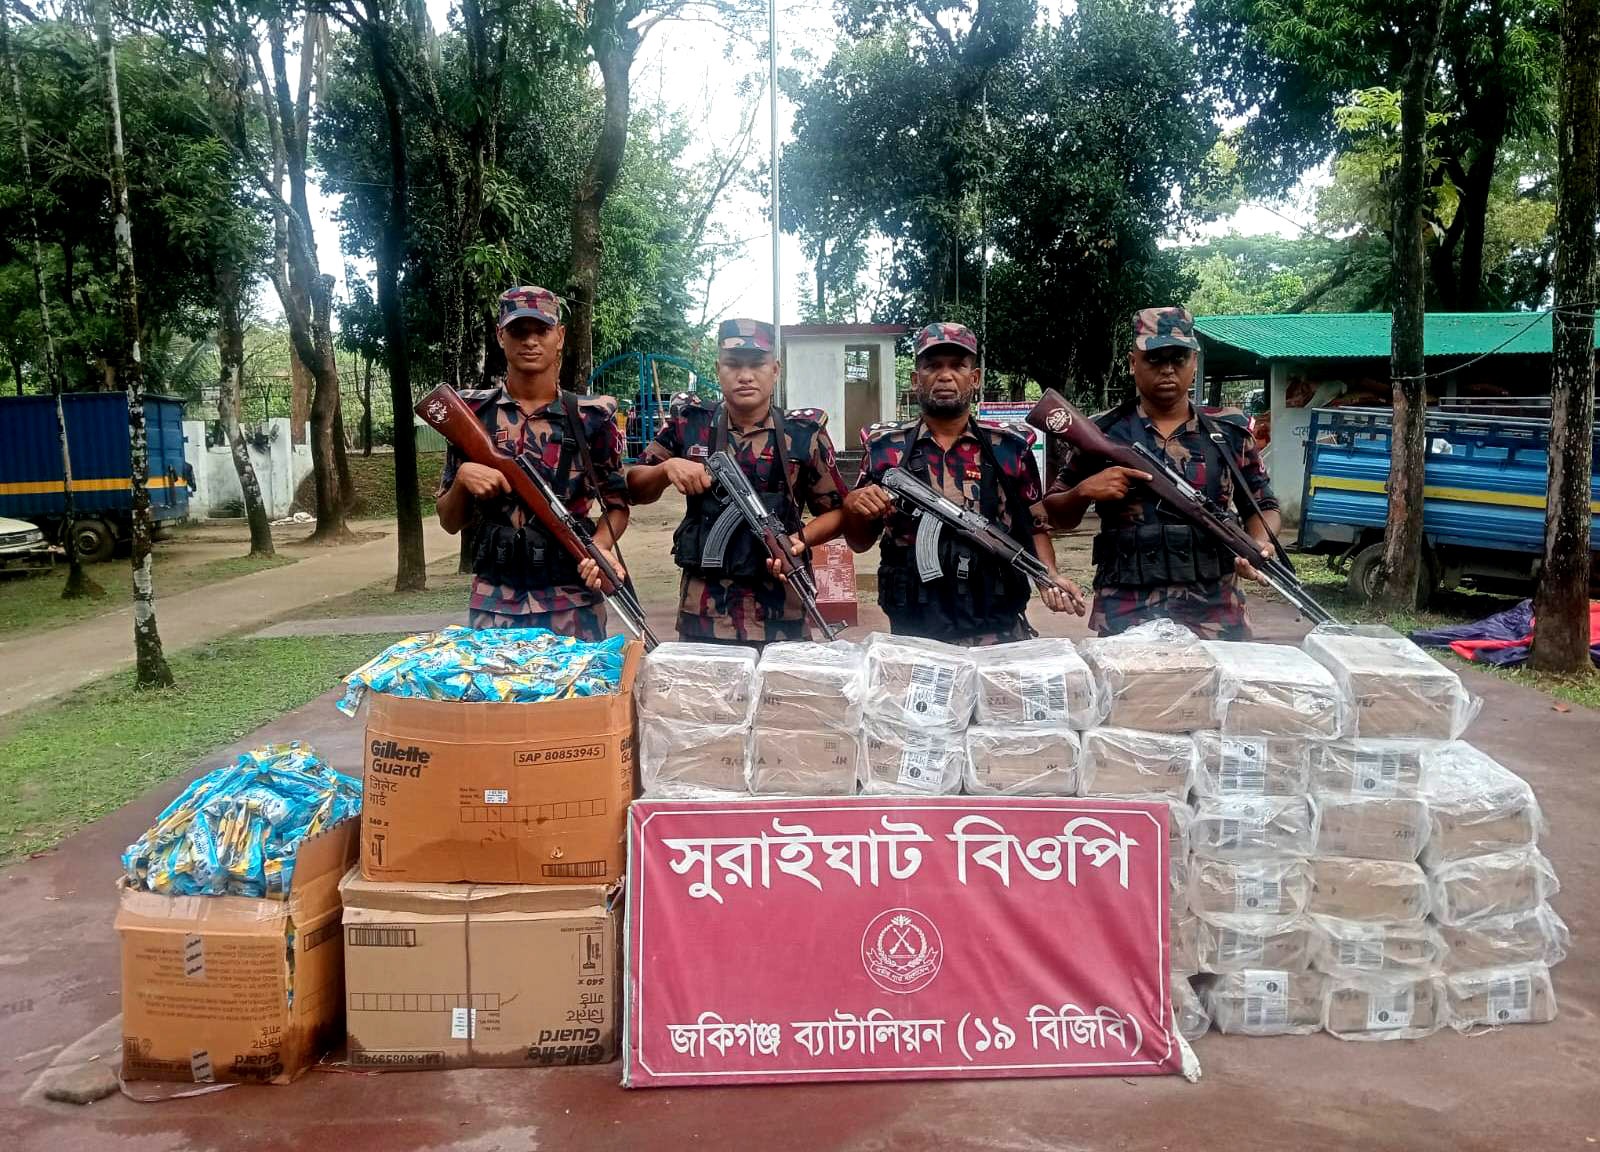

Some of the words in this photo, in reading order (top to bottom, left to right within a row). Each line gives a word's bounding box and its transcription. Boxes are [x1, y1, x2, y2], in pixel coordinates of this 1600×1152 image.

[371, 740, 431, 763] Gillette
[518, 752, 541, 763] SAP
[544, 746, 600, 761] 80853945
[372, 758, 421, 778] Guard
[661, 814, 934, 905] সুরাইঘাট
[945, 814, 1139, 890] বিওপি
[579, 992, 604, 1009] गार्ड
[565, 1008, 604, 1025] जिलेट
[537, 1027, 600, 1045] Guard
[665, 1010, 781, 1058] জকিগঞ্জ
[790, 1007, 946, 1057] ব্যাটালিয়ন
[957, 1012, 1017, 1061] (১৯
[1025, 1003, 1143, 1057] বিজিবি)
